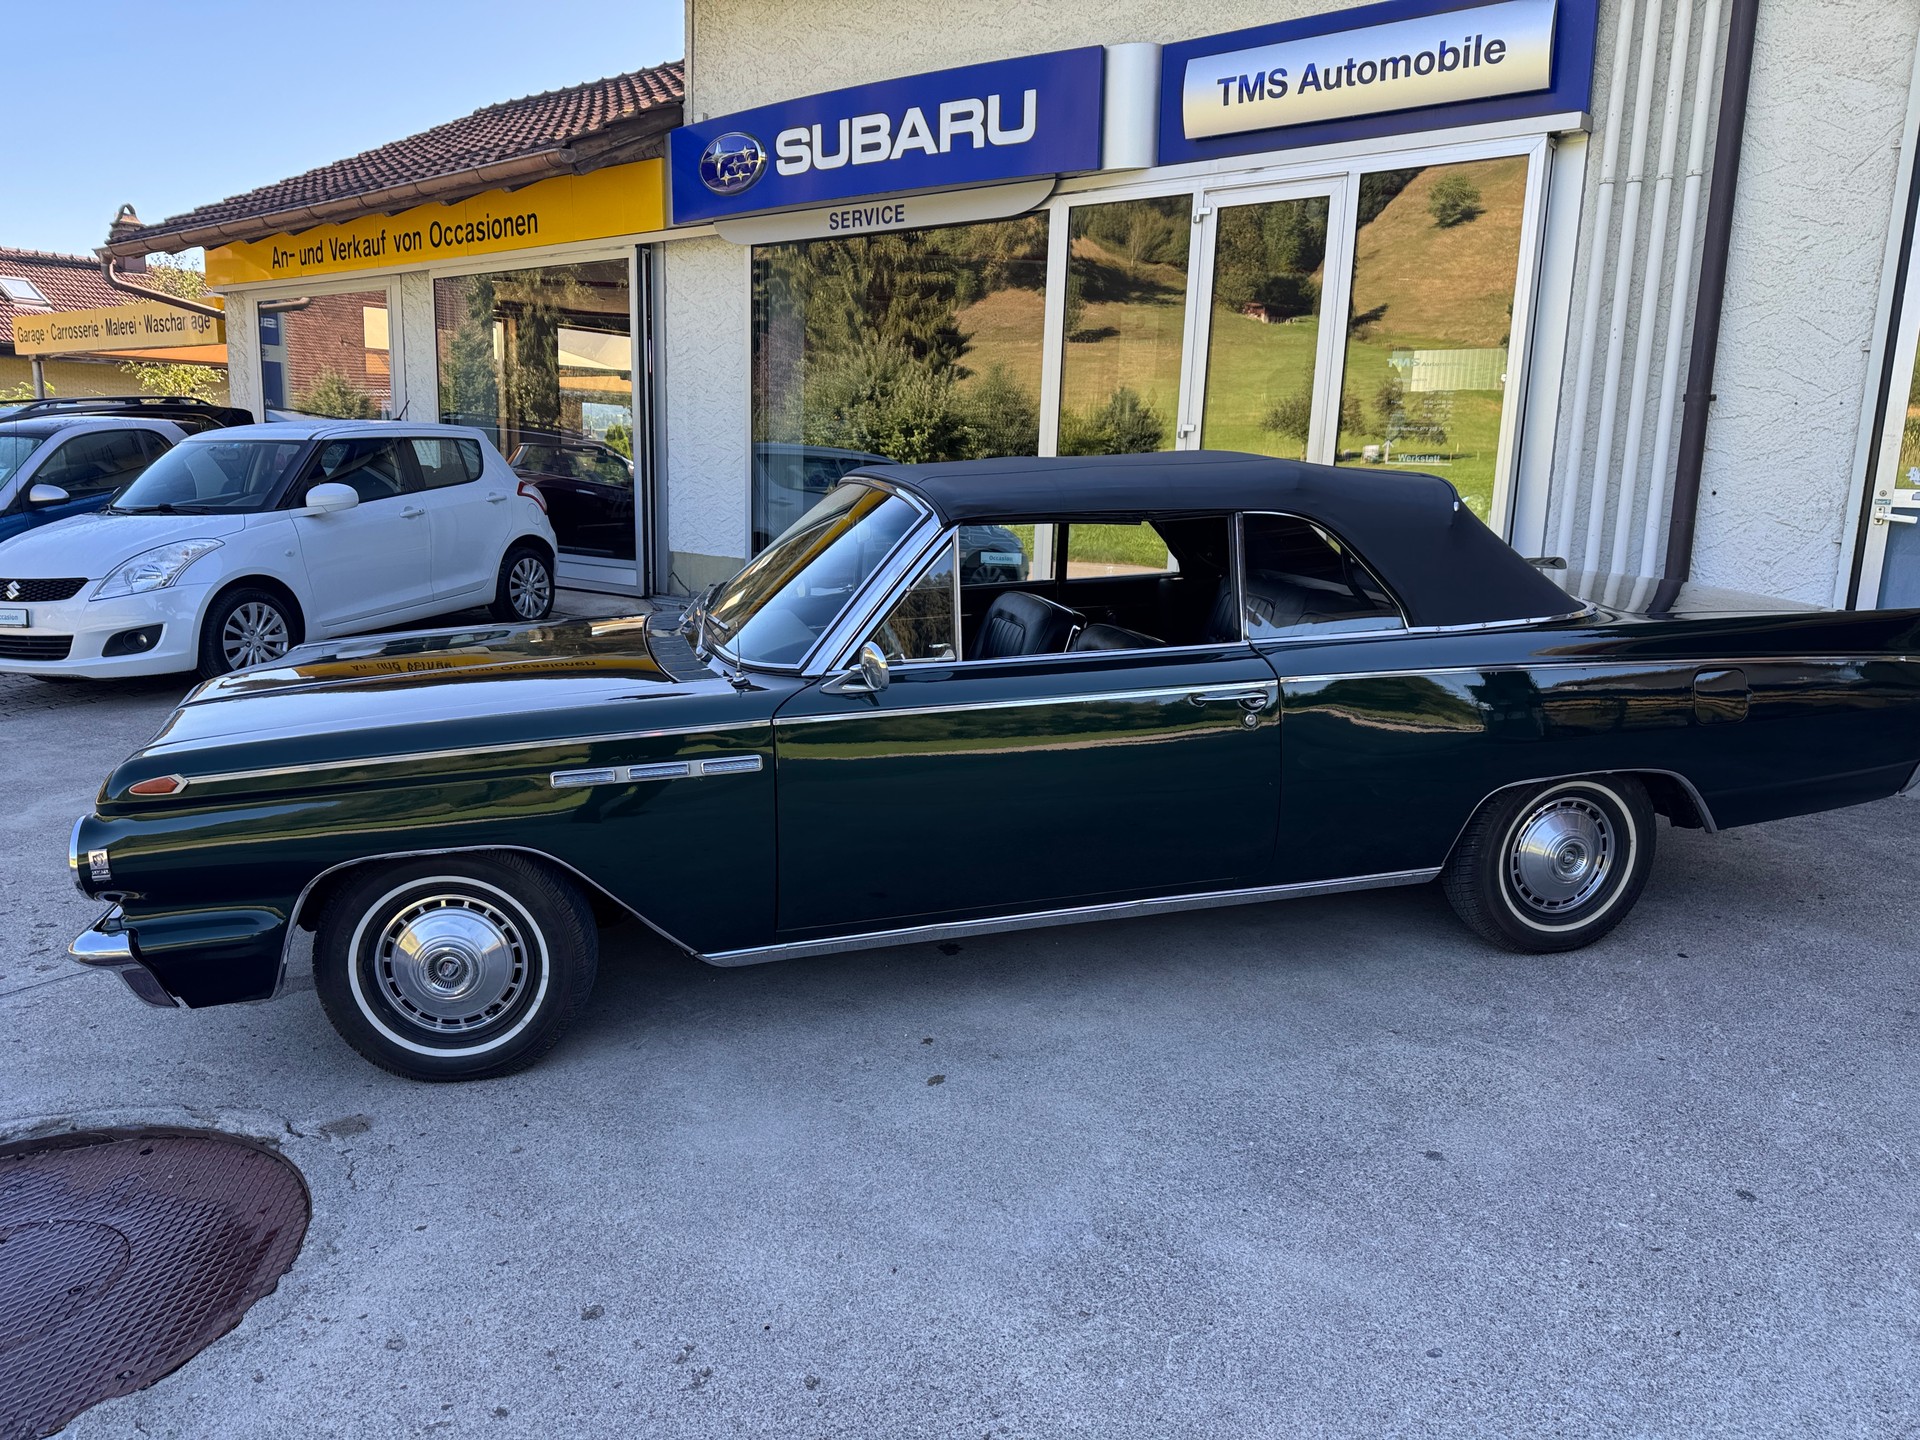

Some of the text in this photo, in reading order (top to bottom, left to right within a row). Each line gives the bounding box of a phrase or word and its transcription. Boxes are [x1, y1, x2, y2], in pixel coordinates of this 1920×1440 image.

[1217, 34, 1507, 106] TMS Automobile
[776, 88, 1037, 176] SUBARU
[829, 204, 905, 230] SERVICE
[272, 212, 538, 269] An- und Verkauf von Occasionen
[17, 326, 45, 345] Garage
[50, 320, 99, 341] Carrosserie
[105, 315, 137, 336] Malerei
[1398, 453, 1440, 463] Werkstatt
